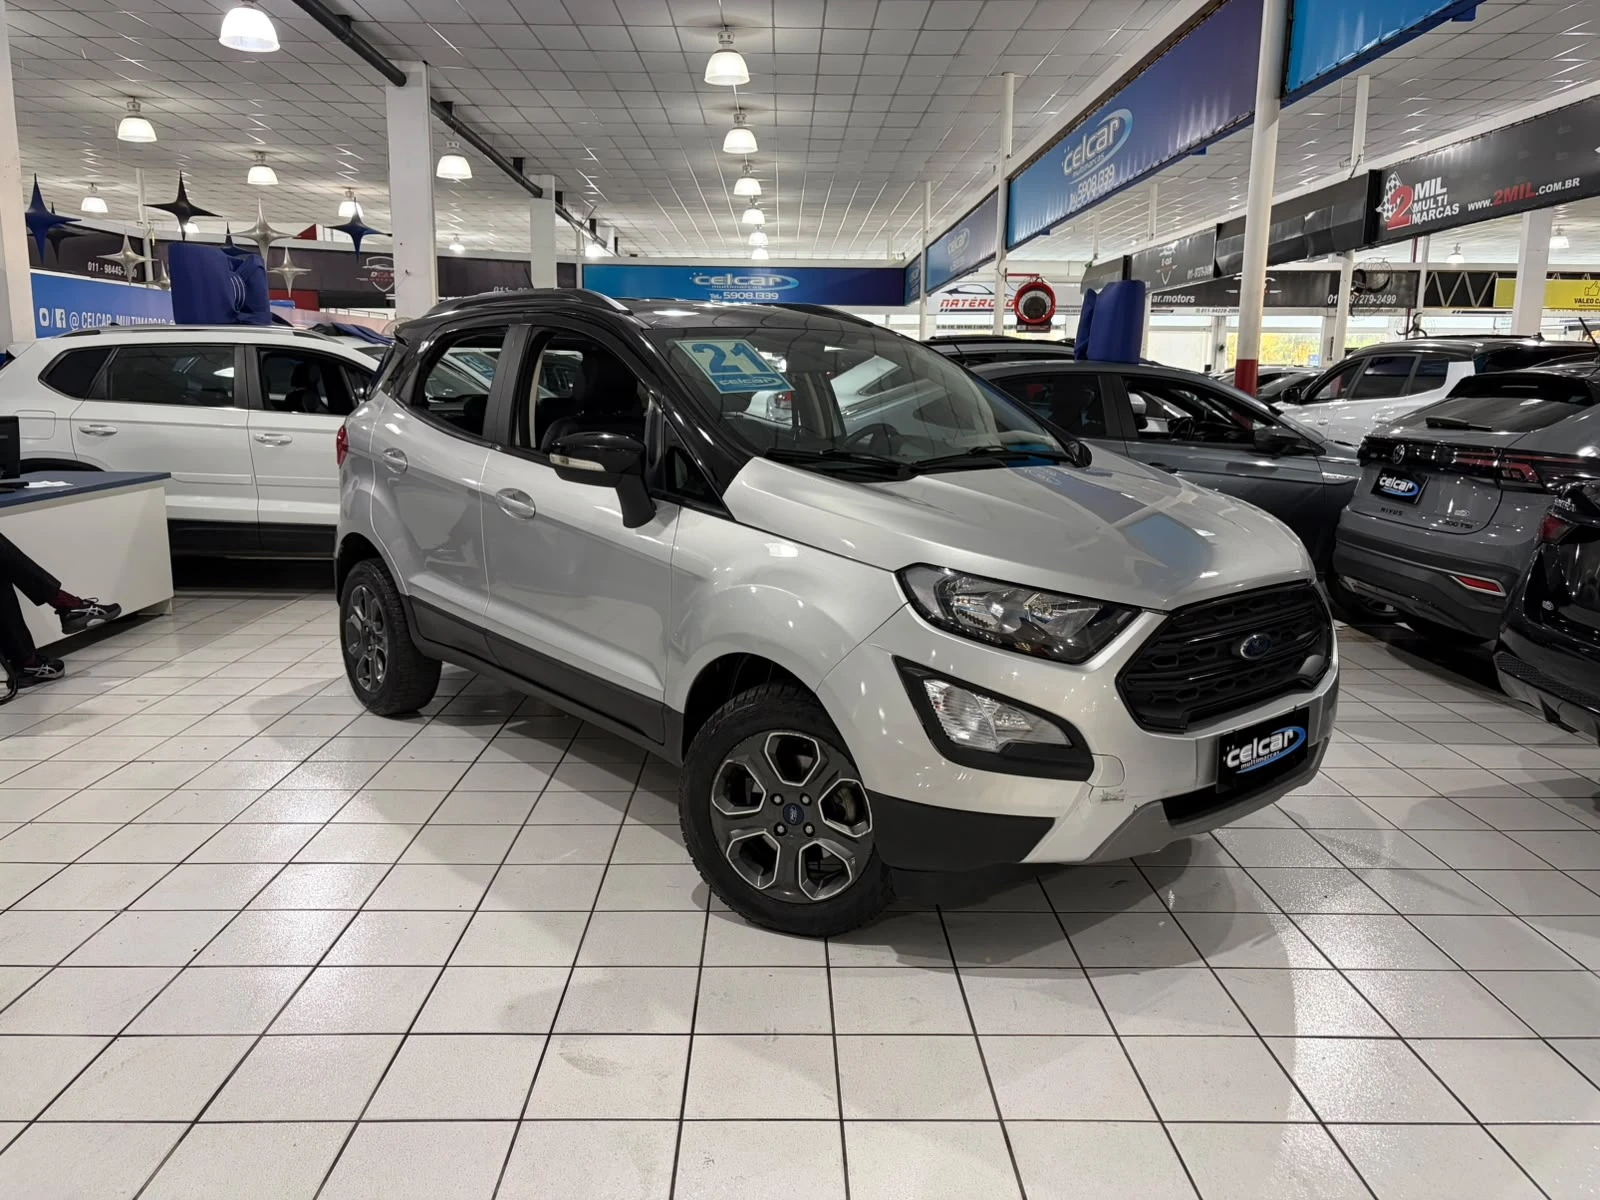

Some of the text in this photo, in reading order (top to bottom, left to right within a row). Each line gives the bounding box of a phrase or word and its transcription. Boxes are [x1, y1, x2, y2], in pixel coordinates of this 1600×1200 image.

[1063, 118, 1119, 176] celcar
[1387, 176, 1448, 231] 2 MIL
[1411, 203, 1460, 225] MARCAS
[1412, 194, 1449, 215] MULTI
[693, 273, 782, 286] celcar
[691, 343, 772, 374] 21
[1379, 475, 1413, 492] celcar
[1226, 728, 1294, 769] celcar
[1240, 750, 1281, 770] multimarcas
